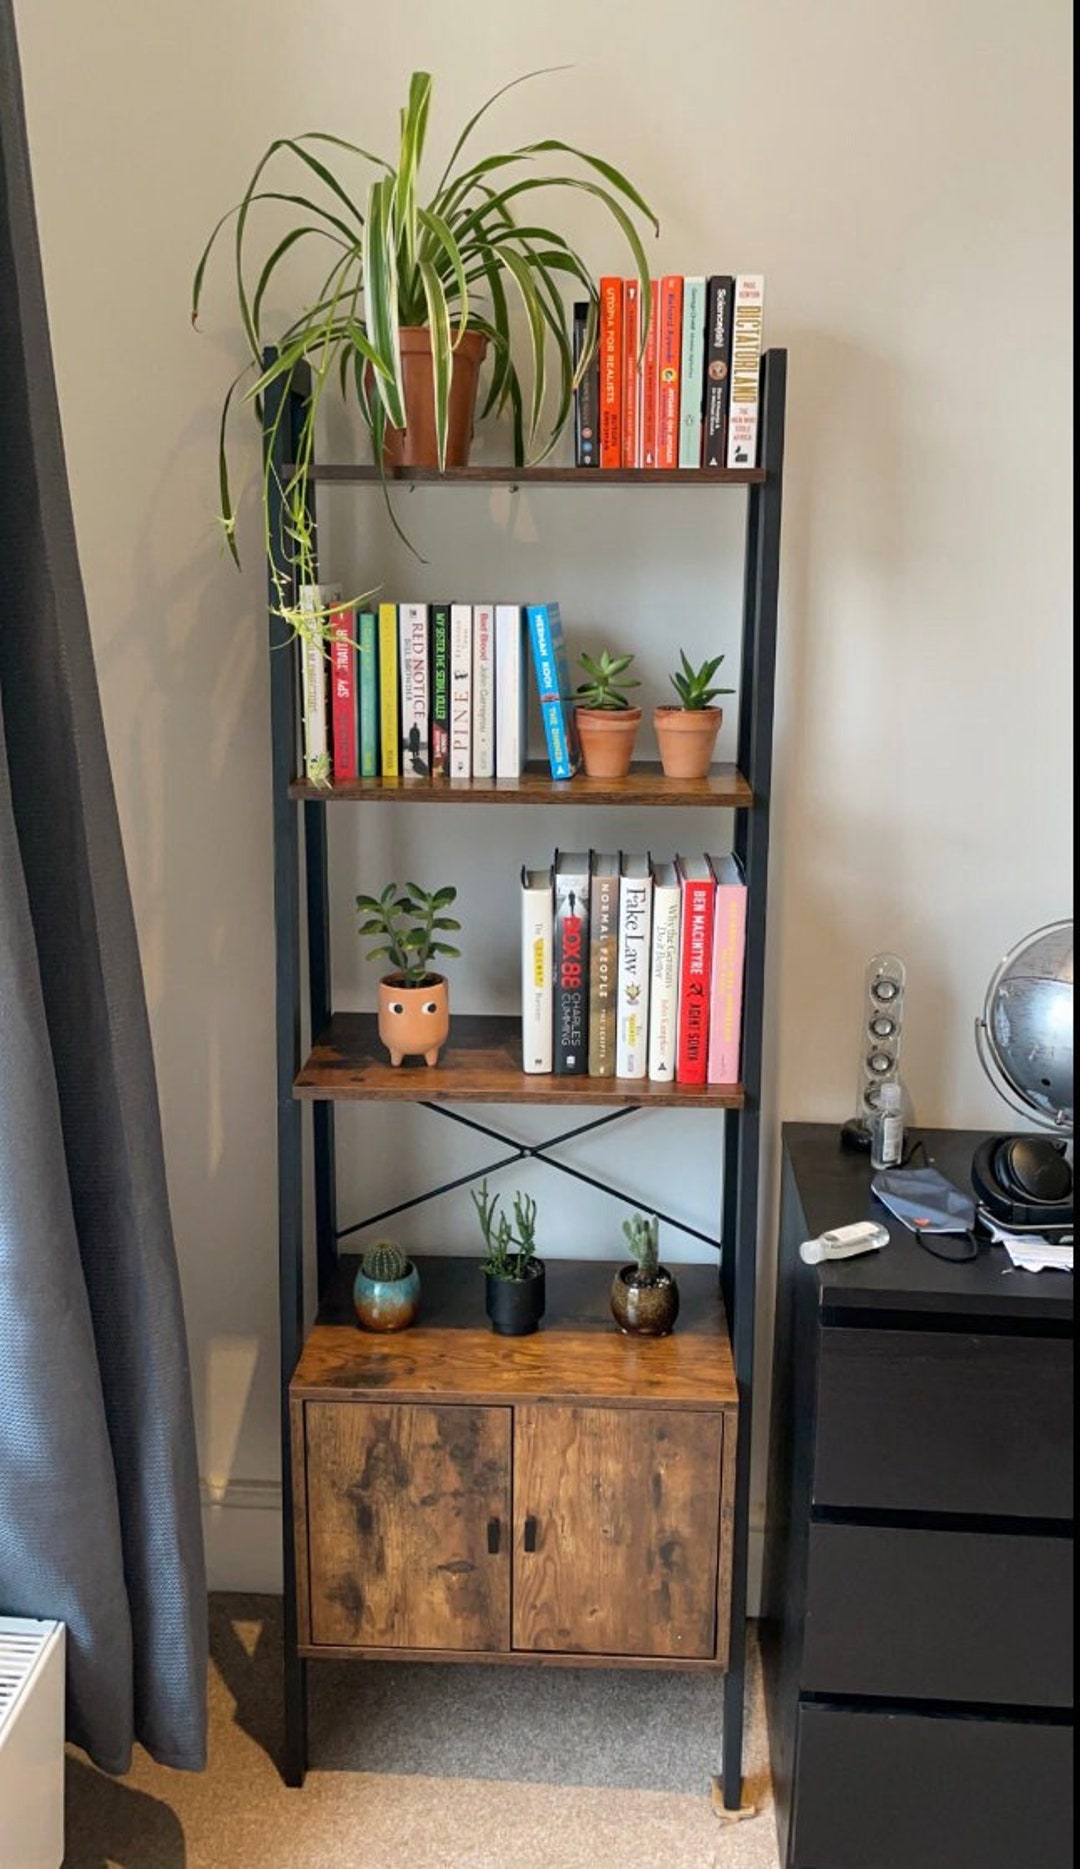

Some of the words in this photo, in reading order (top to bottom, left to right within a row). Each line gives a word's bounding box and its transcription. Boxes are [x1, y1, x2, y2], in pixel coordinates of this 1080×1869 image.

[713, 288, 726, 348] Science(ish)
[732, 306, 761, 403] DICTATORLAND
[435, 613, 445, 626] MY
[480, 613, 489, 630] Bad
[412, 623, 425, 654] RED
[480, 634, 489, 661] Blood
[535, 614, 548, 656] HERMAN
[337, 630, 348, 671] TRAITR
[436, 654, 445, 668] THE
[337, 678, 349, 698] SPY
[412, 659, 425, 719] NOTICE
[436, 670, 445, 694] SERIAL
[479, 665, 488, 687] John
[541, 662, 553, 688] KOCH
[436, 696, 446, 719] KILLER
[453, 692, 469, 751] PINE
[549, 707, 557, 725] THE
[599, 884, 609, 941] NORMAL
[626, 887, 646, 930] Fake
[693, 890, 706, 911] BEN
[666, 905, 677, 927] Why
[562, 917, 581, 959] BOX
[655, 926, 665, 942] Do
[667, 928, 677, 943] the
[690, 915, 705, 975] MACINTYRE
[624, 934, 644, 975] Law
[665, 945, 676, 989] Germans
[561, 962, 581, 990] 88
[599, 948, 608, 998] PEOPLE
[561, 993, 570, 1046] CUMMING
[571, 993, 581, 1046] CHARLES
[689, 1003, 701, 1031] AGENT
[687, 1033, 700, 1062] SONYA
